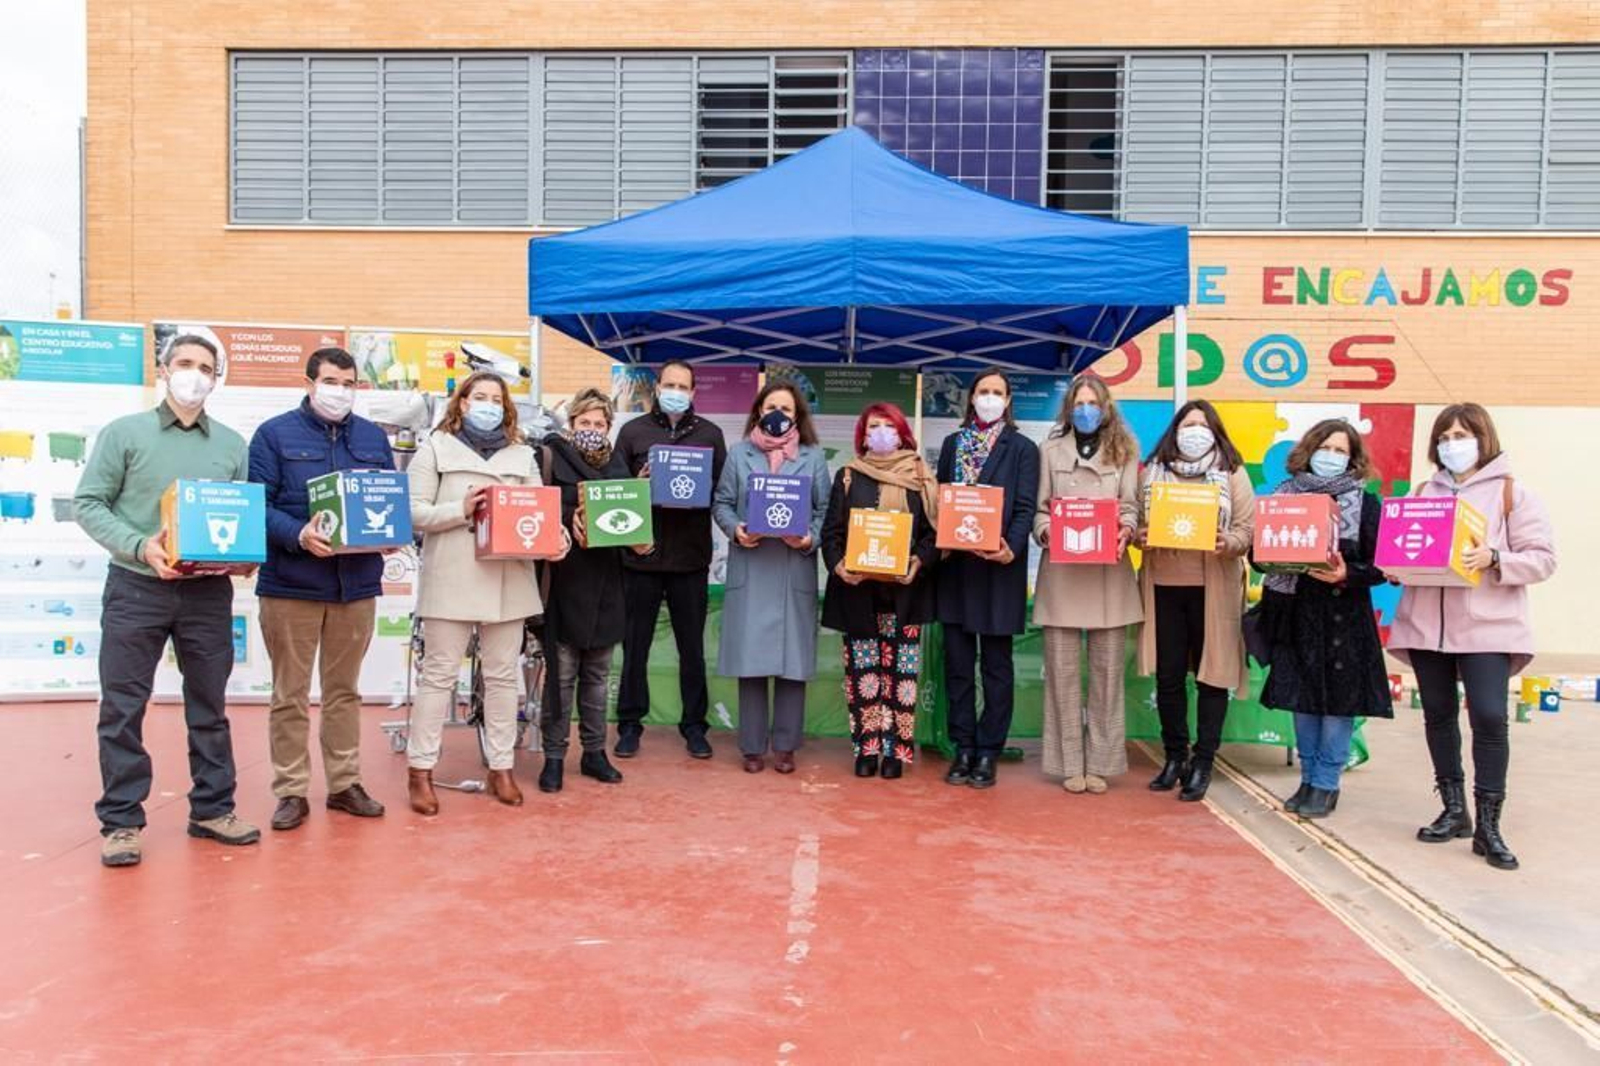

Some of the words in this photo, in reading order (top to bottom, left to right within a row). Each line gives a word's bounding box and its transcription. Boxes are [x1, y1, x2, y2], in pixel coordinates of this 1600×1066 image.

[1196, 266, 1227, 305] E
[1262, 266, 1573, 307] ENCAJAMOS
[36, 328, 60, 337] CASA
[237, 333, 256, 341] CON
[257, 334, 274, 342] LOS
[22, 338, 60, 348] CENTRO
[259, 343, 302, 353] RESIDUOS
[1083, 333, 1396, 390] OD@S
[658, 450, 670, 463] 17
[344, 477, 359, 494] 16
[753, 477, 765, 491] 17
[184, 486, 196, 503] 6
[499, 490, 507, 506] 5
[588, 486, 602, 501] 13
[944, 490, 952, 503] 9
[1156, 487, 1163, 500] 7
[1054, 503, 1062, 517] 4
[1260, 500, 1265, 515] 1
[1385, 503, 1400, 518] 10
[853, 514, 863, 526] 11
